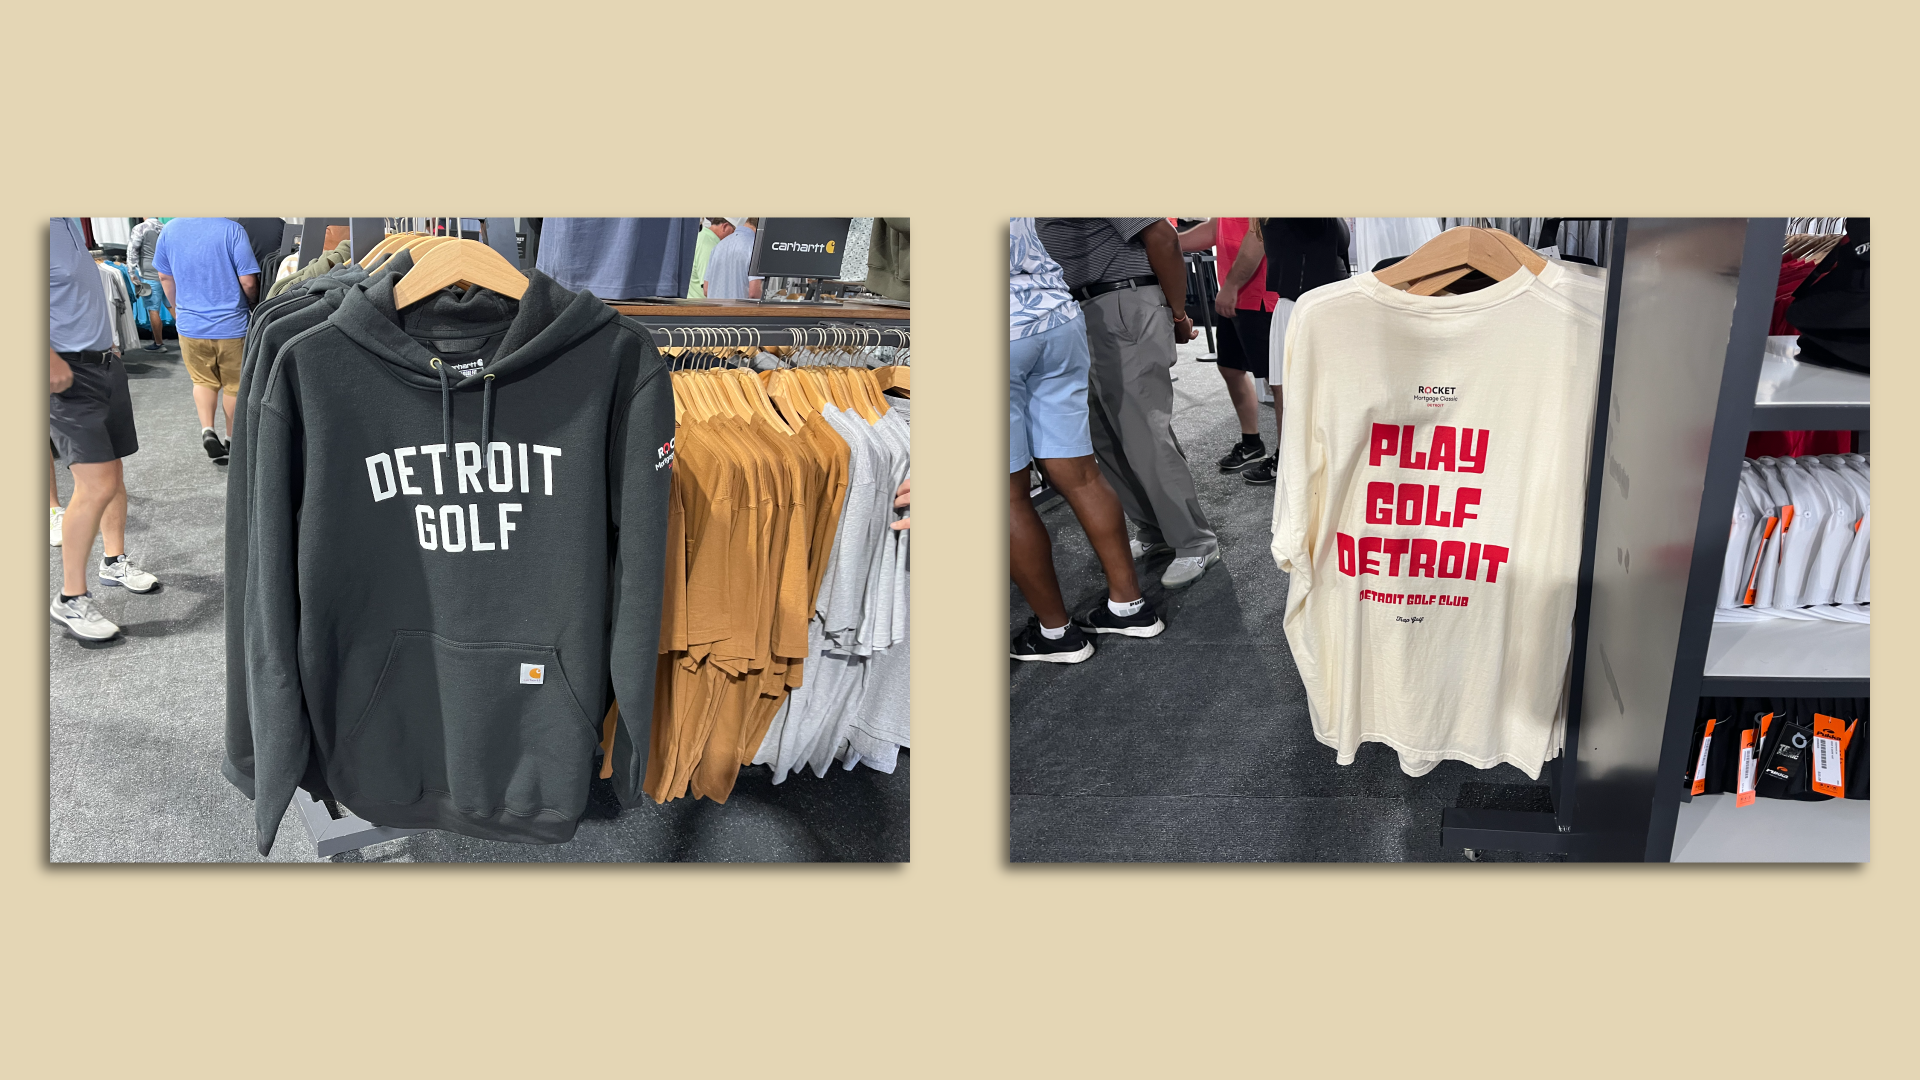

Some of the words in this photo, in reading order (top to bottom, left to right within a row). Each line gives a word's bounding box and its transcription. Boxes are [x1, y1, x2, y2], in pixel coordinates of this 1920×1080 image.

[771, 241, 825, 253] carhartt
[1418, 386, 1456, 395] ROCKET
[657, 436, 676, 459] ROC
[1369, 422, 1490, 474] PLAY
[365, 441, 562, 502] DETROIT
[1365, 481, 1482, 528] GOLF
[415, 503, 523, 552] GOLF
[1336, 532, 1510, 583] DETROIT
[1359, 589, 1405, 605] DETROIT
[1406, 594, 1437, 606] GOLF
[1438, 595, 1470, 607] CLUB
[1816, 731, 1842, 741] Pukka
